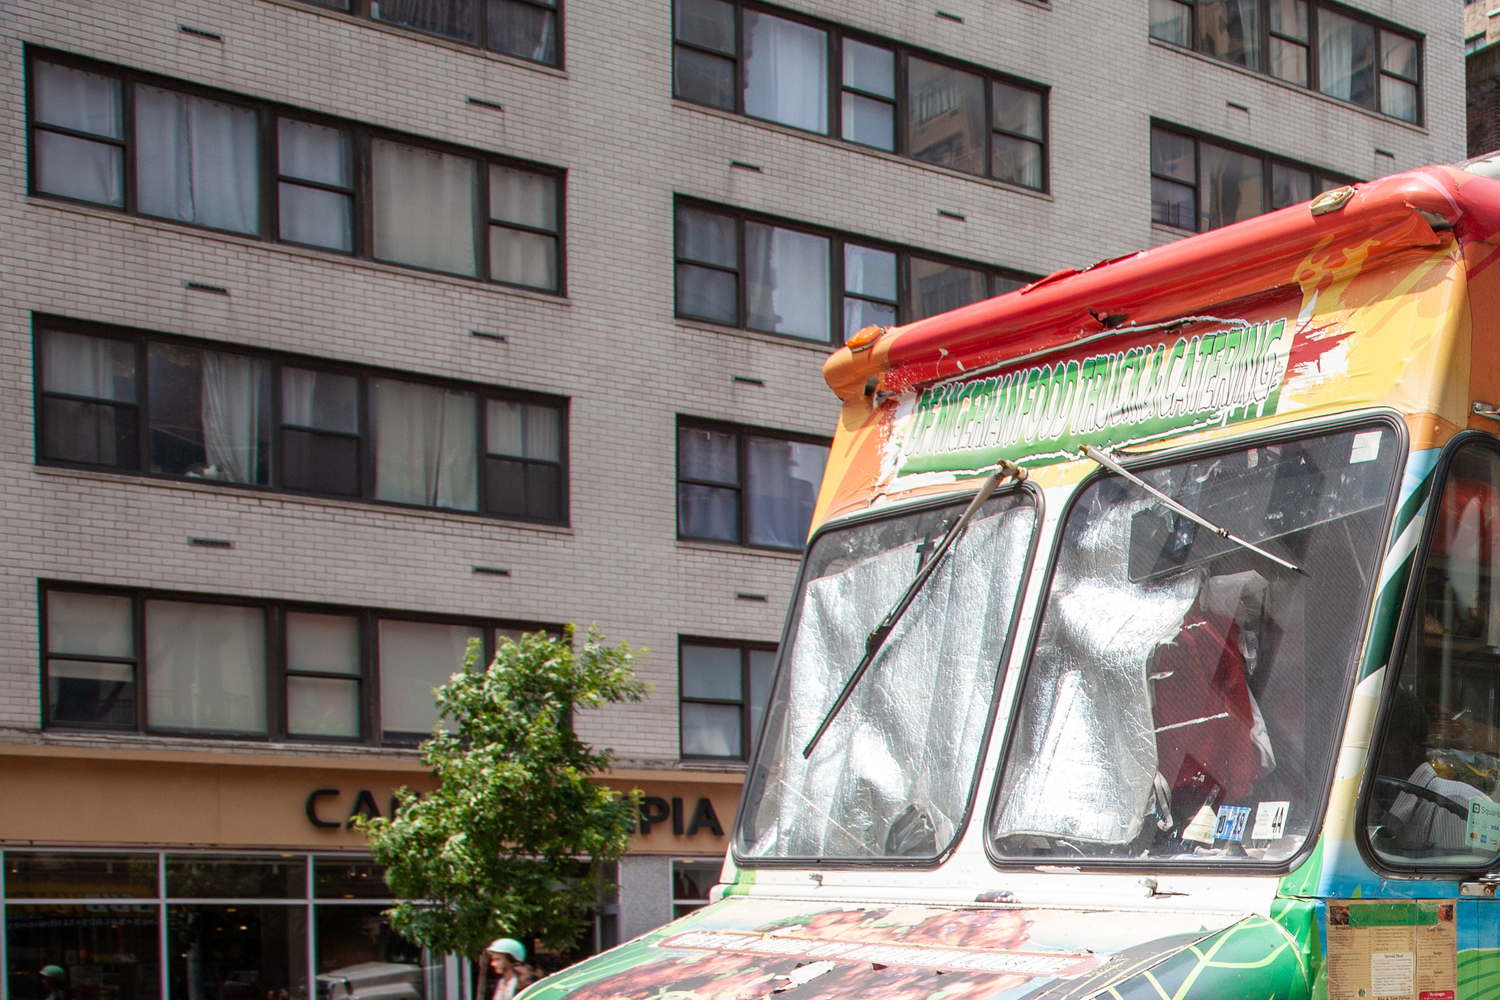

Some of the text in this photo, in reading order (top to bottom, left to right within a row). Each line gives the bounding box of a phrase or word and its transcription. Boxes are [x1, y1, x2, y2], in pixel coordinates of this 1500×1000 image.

[904, 317, 1287, 457] DF NIGERIAN FOOD TRUCK & CATERING
[1271, 806, 1285, 834] 44
[1481, 806, 1500, 818] Square
[948, 952, 1086, 975] CUISINE
